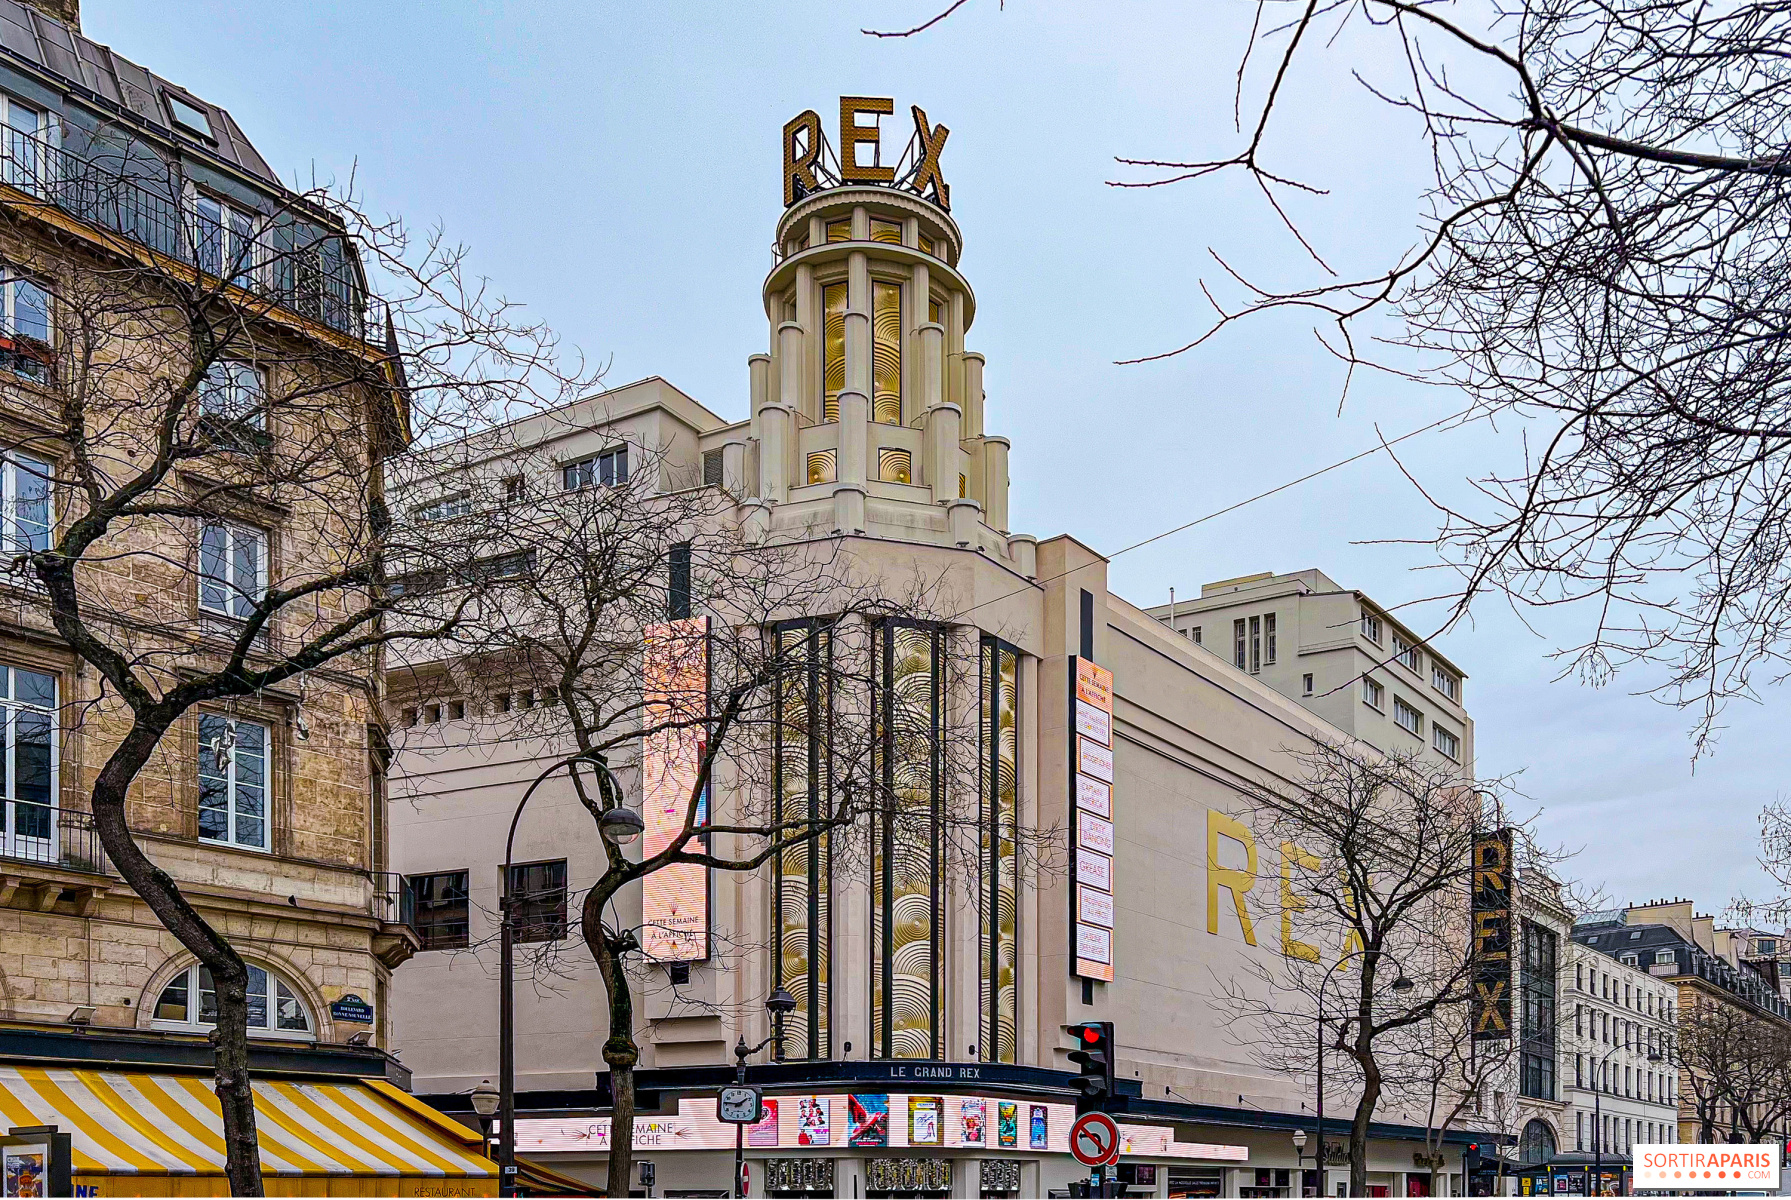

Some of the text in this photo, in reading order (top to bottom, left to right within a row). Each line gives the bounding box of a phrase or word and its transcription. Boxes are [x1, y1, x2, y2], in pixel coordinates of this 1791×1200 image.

[783, 96, 951, 212] REX
[1206, 809, 1374, 972] REX
[669, 916, 699, 925] SEMAINE
[1475, 840, 1507, 1031] REX
[890, 1066, 980, 1079] LE GRAND REX
[631, 1123, 673, 1134] EMAINE
[414, 1187, 476, 1198] RESTAURANT
